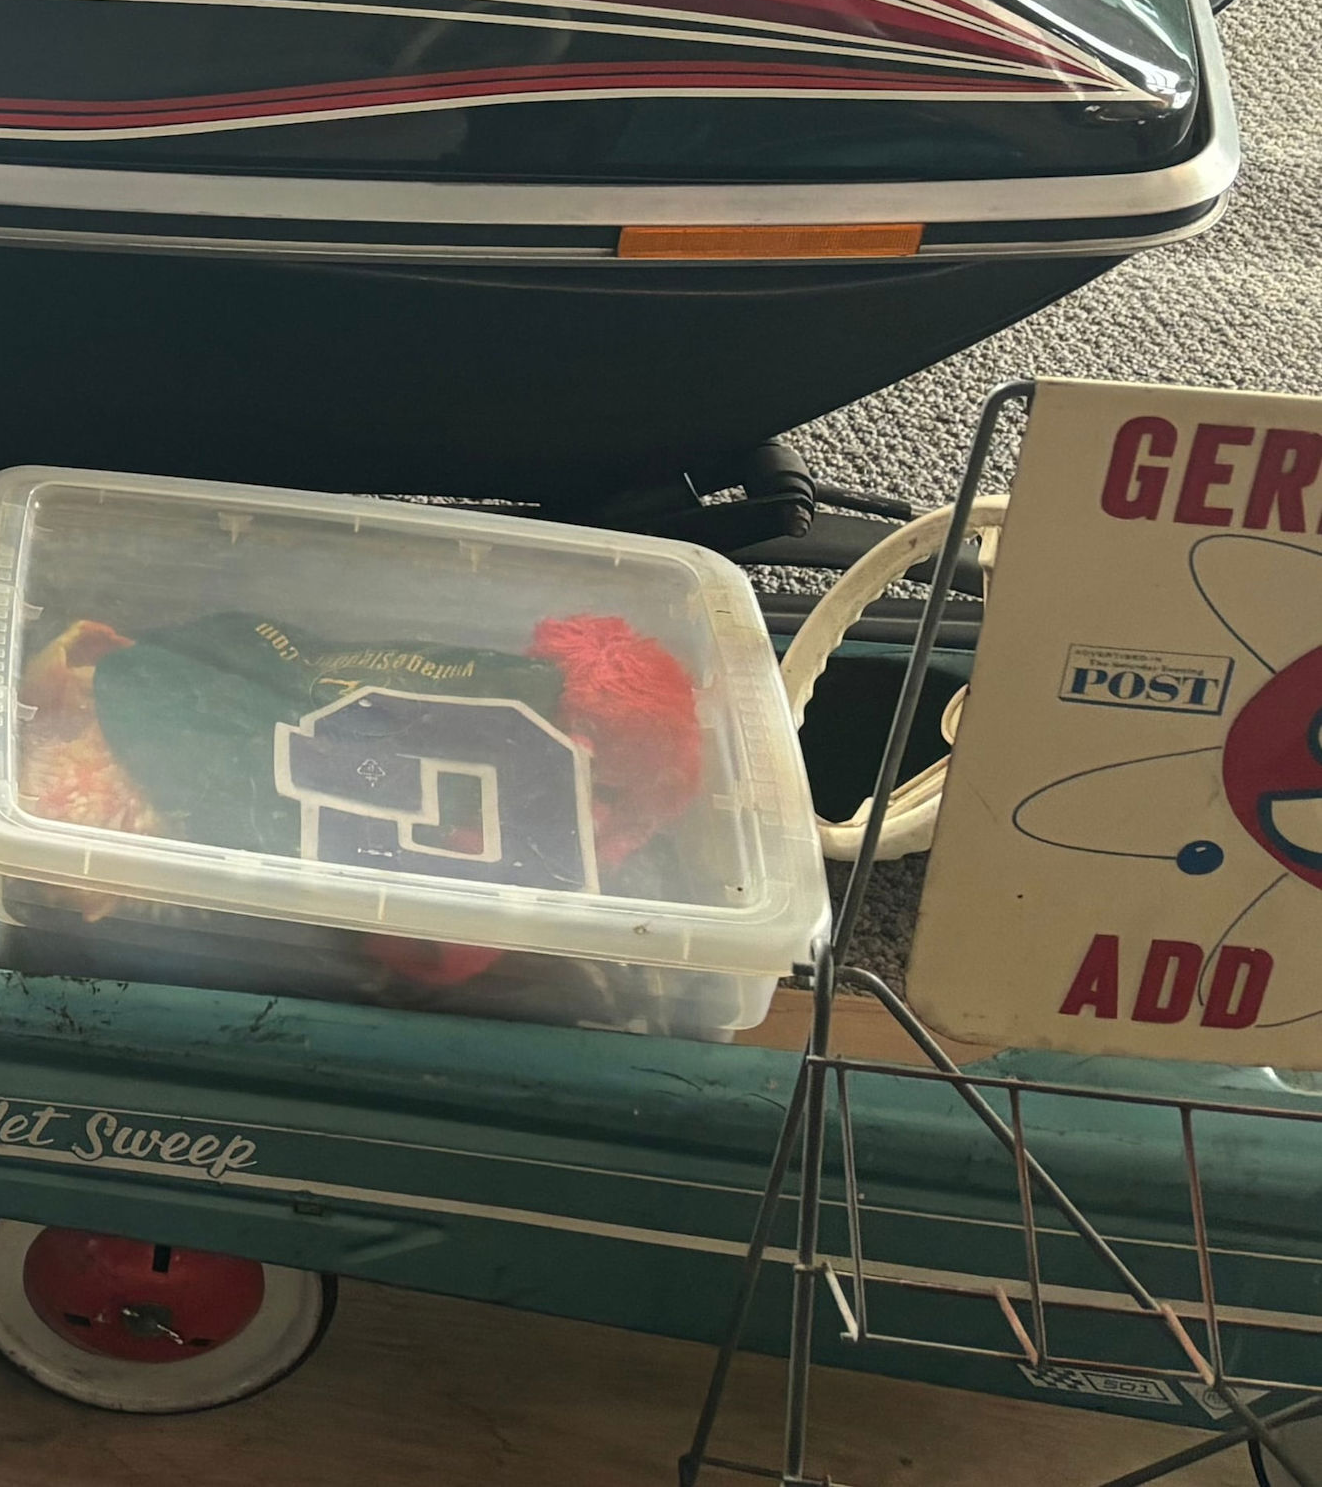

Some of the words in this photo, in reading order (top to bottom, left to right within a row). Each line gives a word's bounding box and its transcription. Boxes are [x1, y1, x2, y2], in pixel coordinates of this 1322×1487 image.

[1101, 415, 1322, 535] GER
[1069, 667, 1220, 706] POST
[1059, 933, 1274, 1030] ADD
[71, 1111, 258, 1178] Sweep
